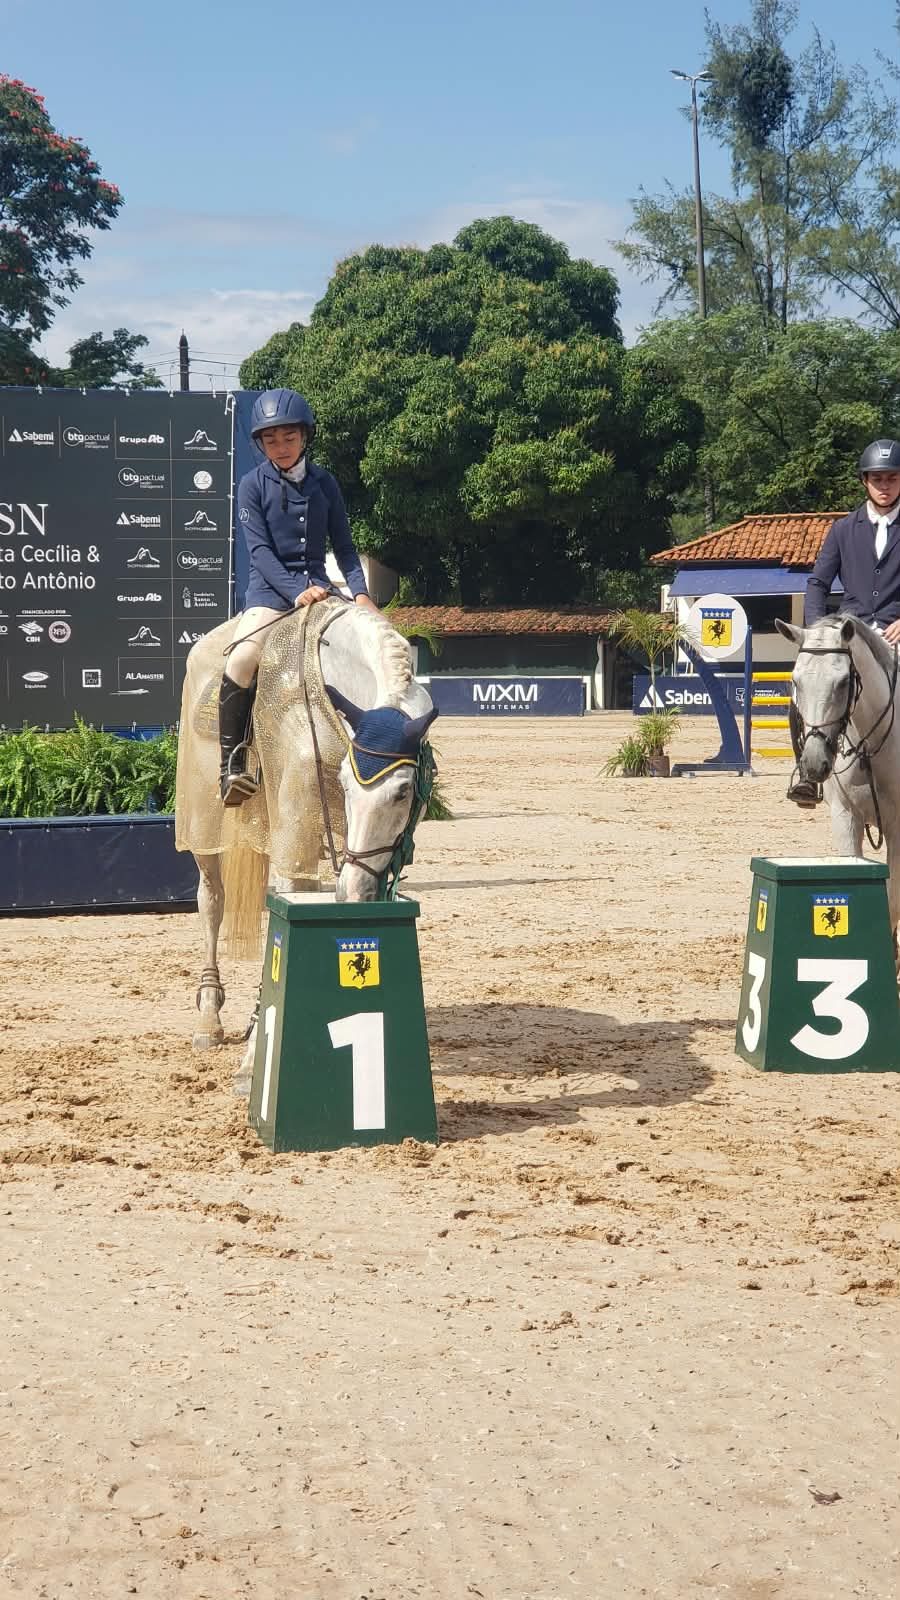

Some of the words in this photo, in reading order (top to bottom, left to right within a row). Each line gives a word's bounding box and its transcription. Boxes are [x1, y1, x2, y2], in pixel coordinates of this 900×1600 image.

[22, 431, 54, 441] Sabemi
[67, 431, 84, 443] btg
[84, 433, 110, 442] pactual
[119, 436, 147, 444] Grupo
[122, 472, 139, 483] btg
[139, 473, 165, 482] pactual
[129, 514, 161, 524] Sabemi
[21, 544, 81, 563] Cecília
[87, 545, 100, 563] &
[181, 555, 198, 566] btg
[198, 556, 223, 565] pactual
[22, 571, 96, 590] Antônio
[116, 595, 145, 603] Grupo
[145, 592, 162, 602] Ab
[472, 683, 538, 702] MXM
[741, 951, 767, 1054] 3
[789, 957, 870, 1060] 3
[259, 1004, 277, 1123] 1
[326, 1011, 387, 1131] 1
